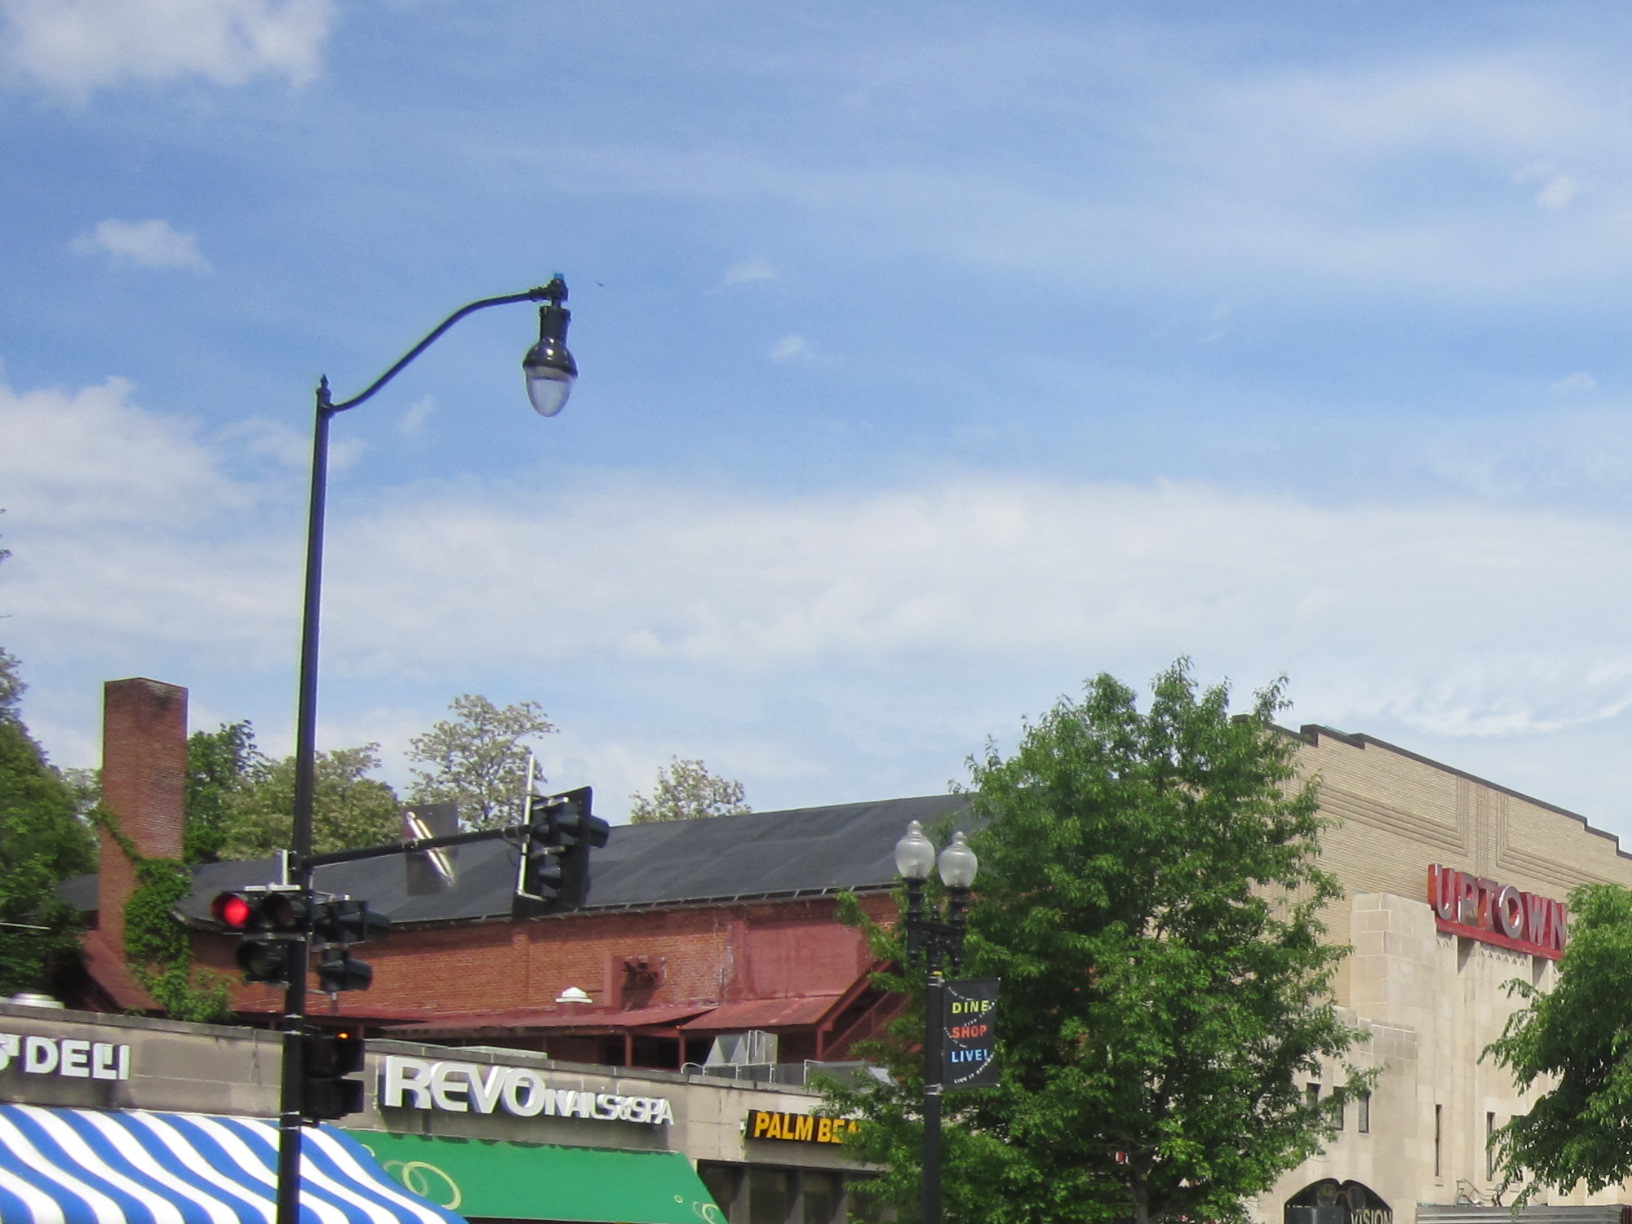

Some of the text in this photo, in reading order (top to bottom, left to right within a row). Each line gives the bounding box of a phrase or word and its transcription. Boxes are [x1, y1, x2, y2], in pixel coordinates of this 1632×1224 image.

[1429, 863, 1567, 950] UPTOWN
[952, 1000, 990, 1014] DINE
[951, 1024, 989, 1039] SHOP
[25, 1035, 131, 1080] DELI
[951, 1049, 988, 1063] LIVE!
[384, 1055, 546, 1117] REVO
[753, 1111, 814, 1141] PALM
